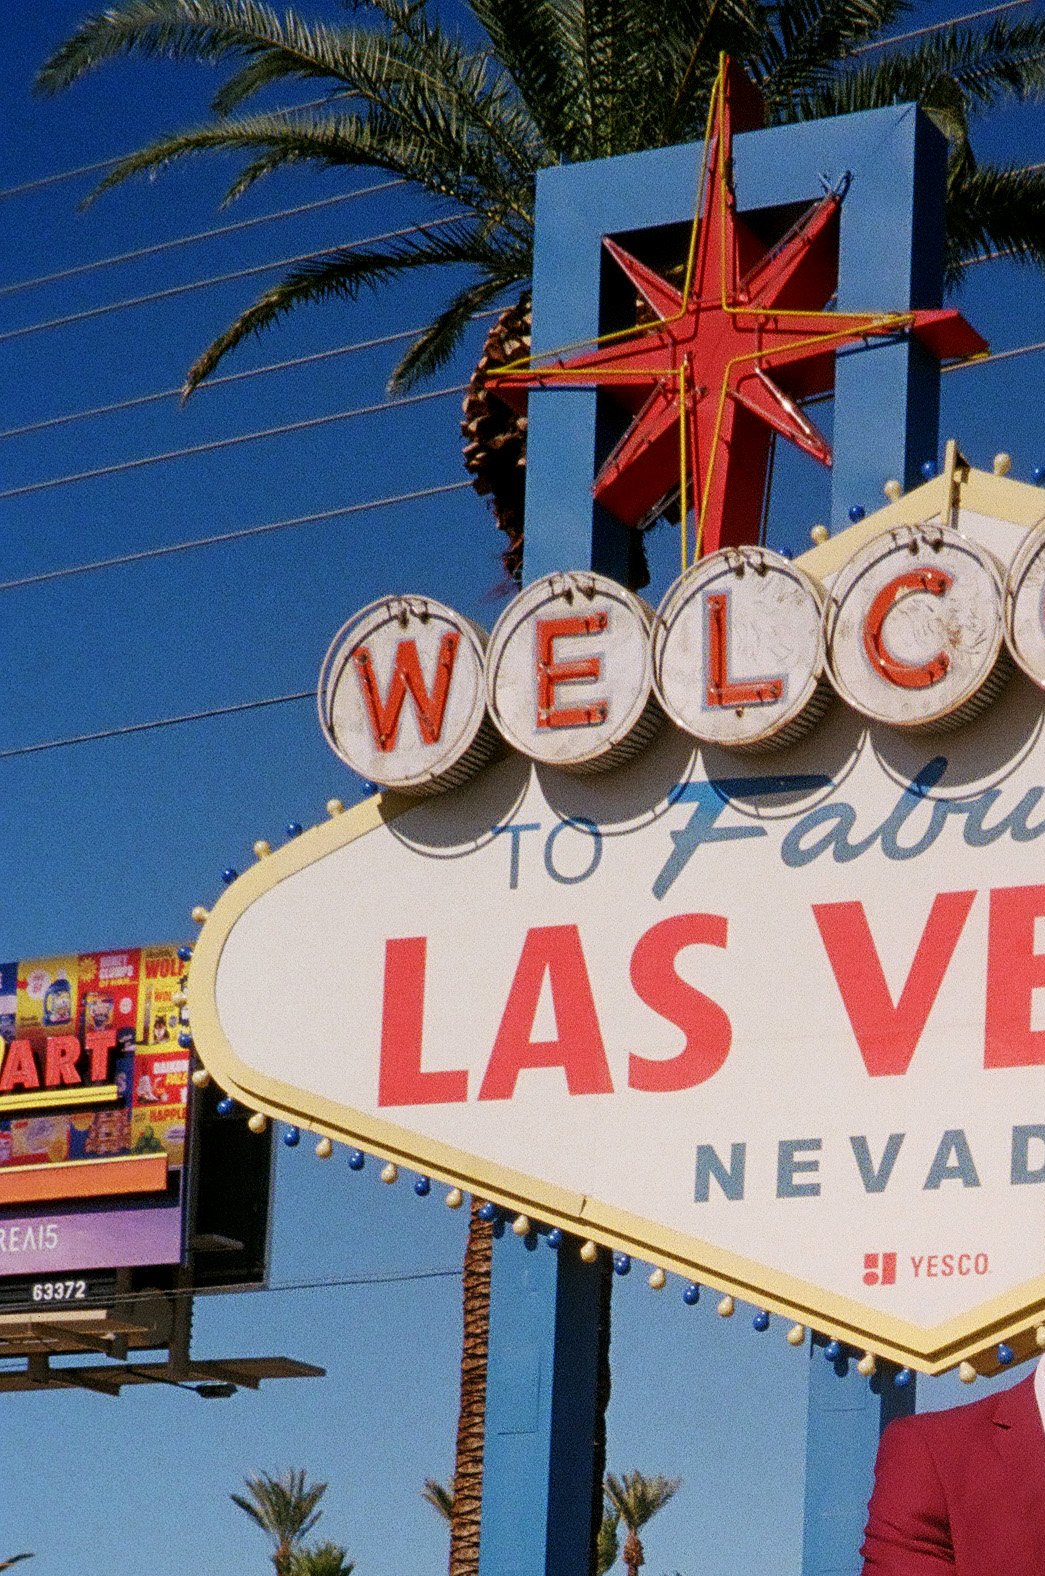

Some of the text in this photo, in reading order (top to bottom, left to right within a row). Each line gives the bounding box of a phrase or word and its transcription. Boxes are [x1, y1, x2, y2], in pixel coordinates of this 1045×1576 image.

[495, 816, 603, 889] TO
[377, 911, 733, 1108] LAS
[910, 1252, 990, 1279] YESCO
[32, 1280, 86, 1302] 63372
